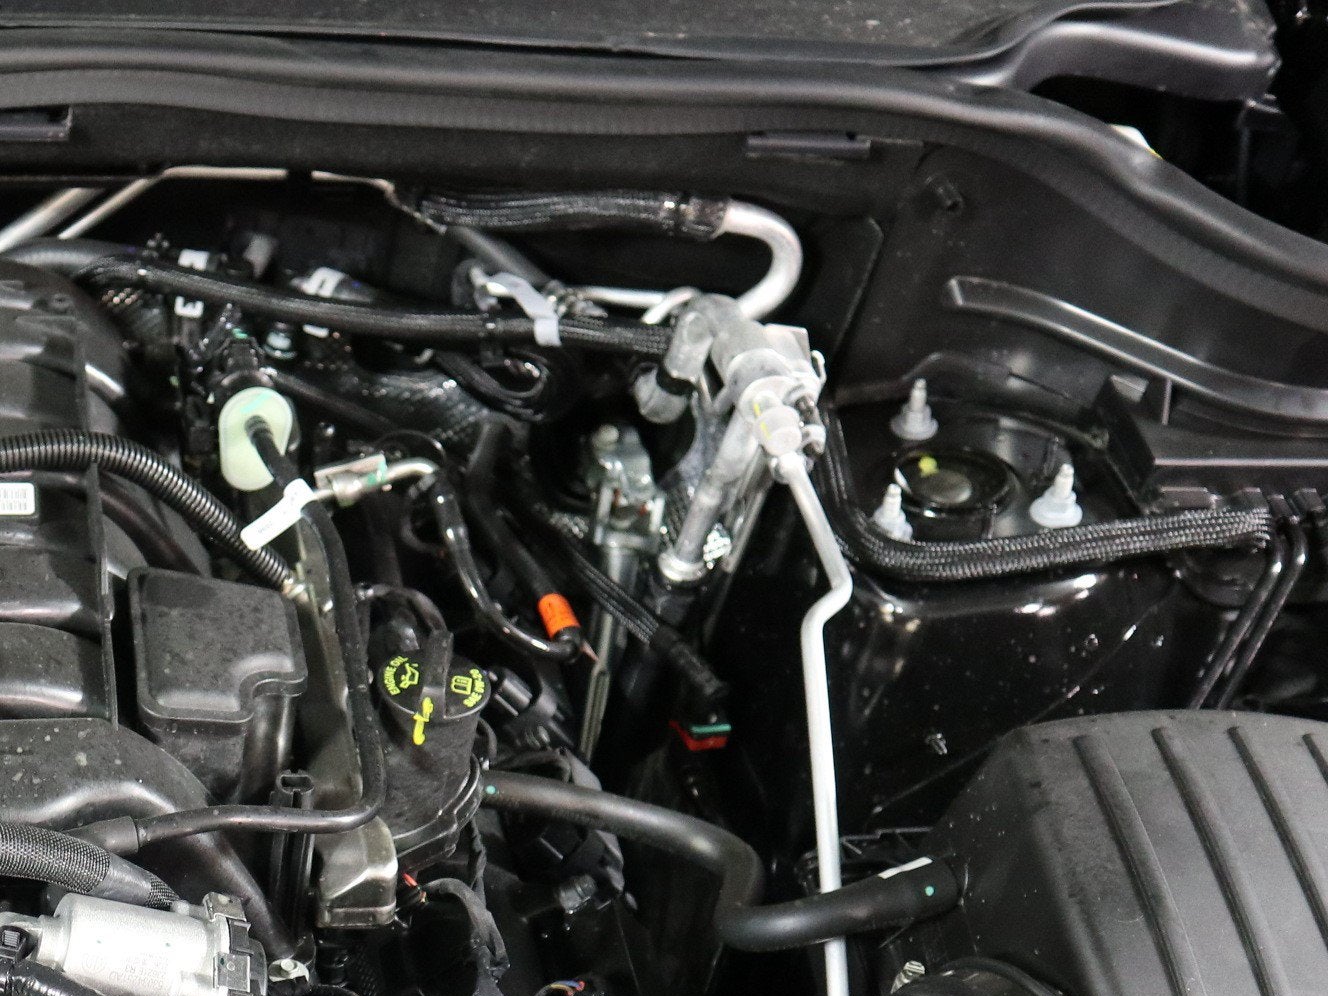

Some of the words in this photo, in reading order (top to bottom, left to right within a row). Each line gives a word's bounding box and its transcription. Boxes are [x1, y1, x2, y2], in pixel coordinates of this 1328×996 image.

[390, 656, 408, 667] OIL
[384, 665, 400, 695] ENGINE
[463, 692, 482, 707] SAE
